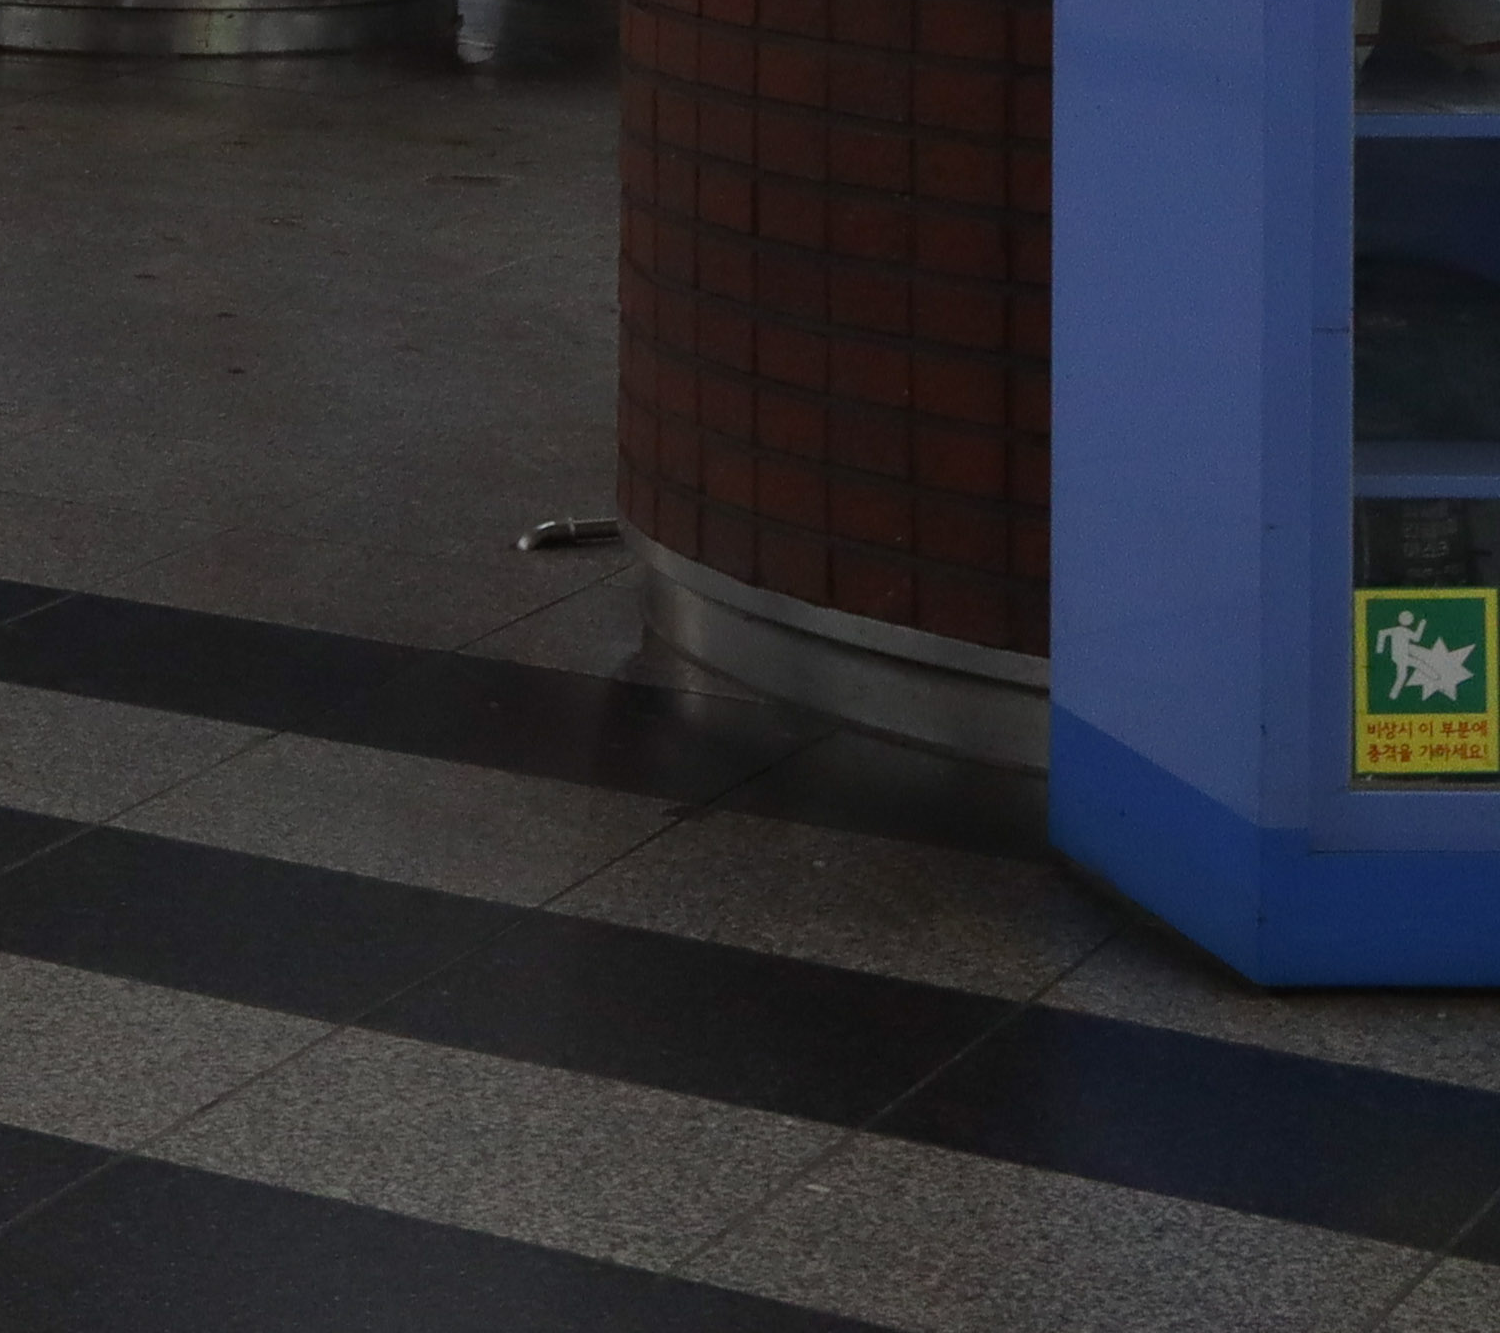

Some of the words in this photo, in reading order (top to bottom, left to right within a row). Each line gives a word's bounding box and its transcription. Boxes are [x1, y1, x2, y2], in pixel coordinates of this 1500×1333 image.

[1366, 722, 1413, 739] 비상시
[1419, 722, 1434, 738] 이
[1441, 721, 1488, 738] 부분에
[1366, 743, 1413, 763] 충격을
